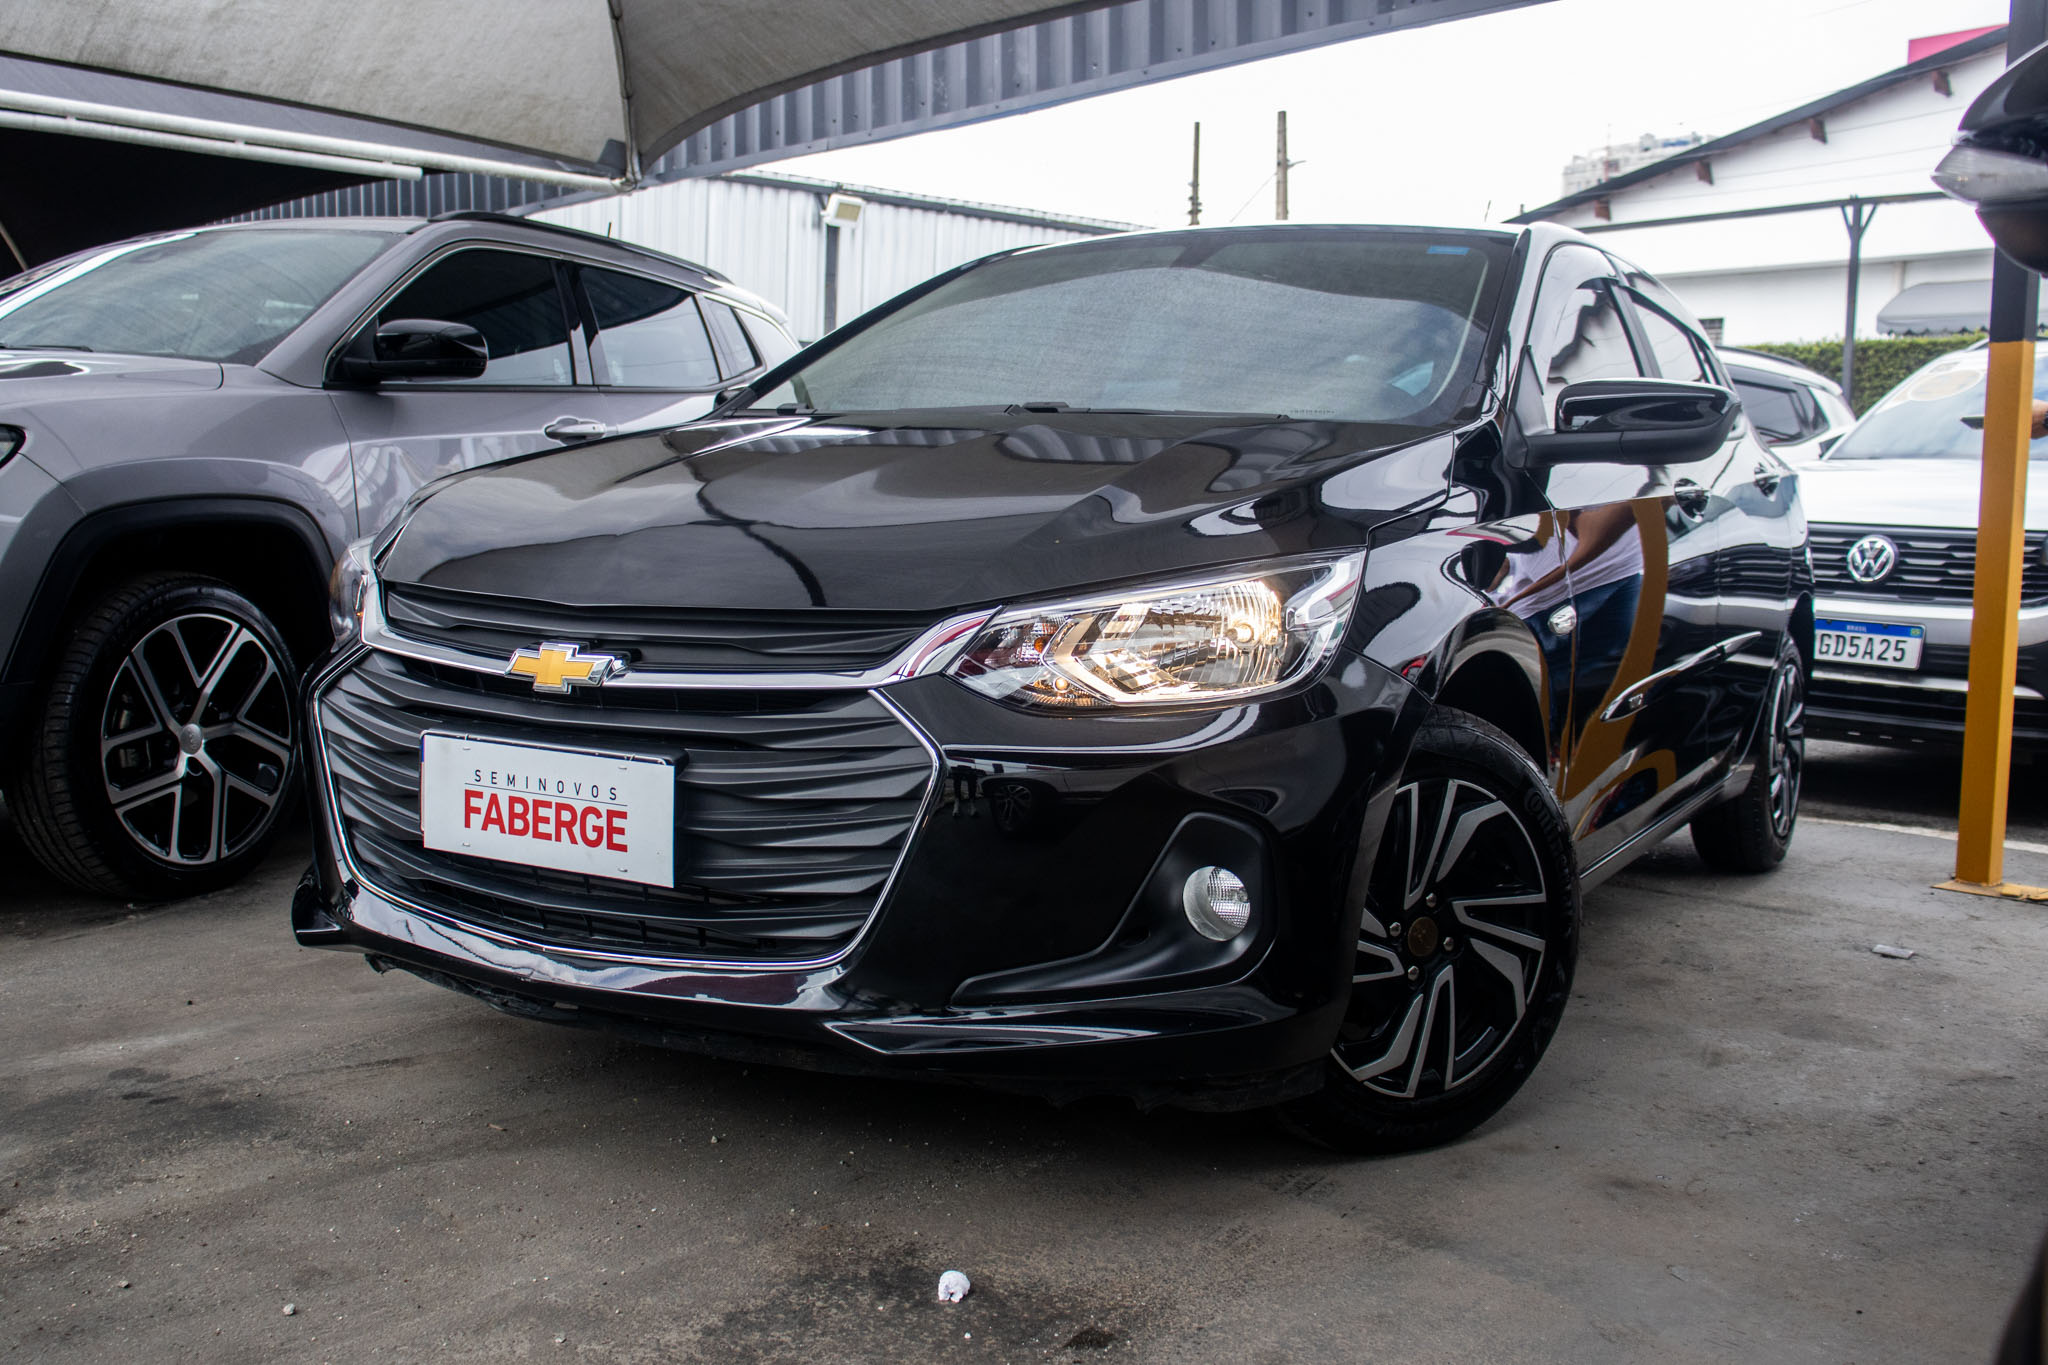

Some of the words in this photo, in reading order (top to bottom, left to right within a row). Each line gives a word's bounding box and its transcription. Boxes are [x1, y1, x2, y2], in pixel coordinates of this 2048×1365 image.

[1818, 633, 1908, 662] GD5A25
[474, 769, 617, 800] SEMINOVOS
[464, 789, 628, 853] FABERGE
